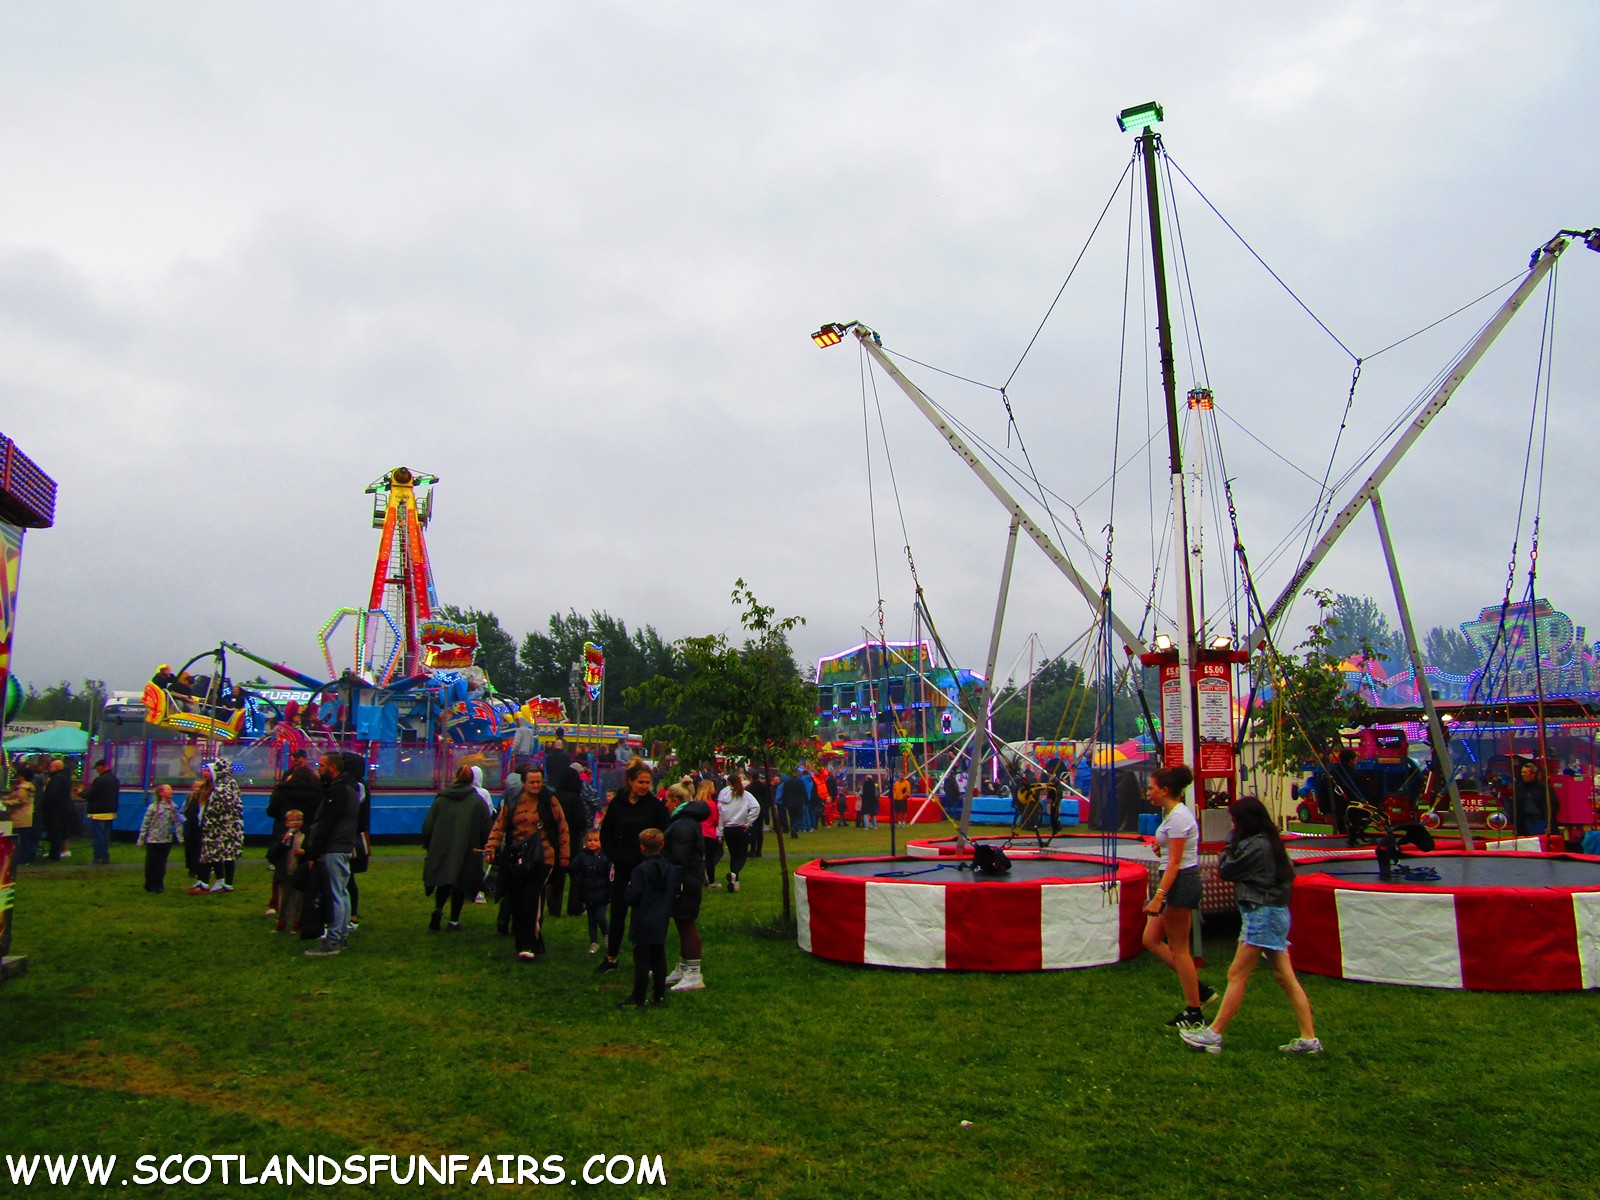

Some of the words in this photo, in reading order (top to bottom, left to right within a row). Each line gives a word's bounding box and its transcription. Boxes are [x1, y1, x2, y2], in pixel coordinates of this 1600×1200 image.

[1265, 560, 1315, 626] ungeetrampolinesuk
[1203, 665, 1224, 674] £5.00
[260, 691, 312, 700] TURBO
